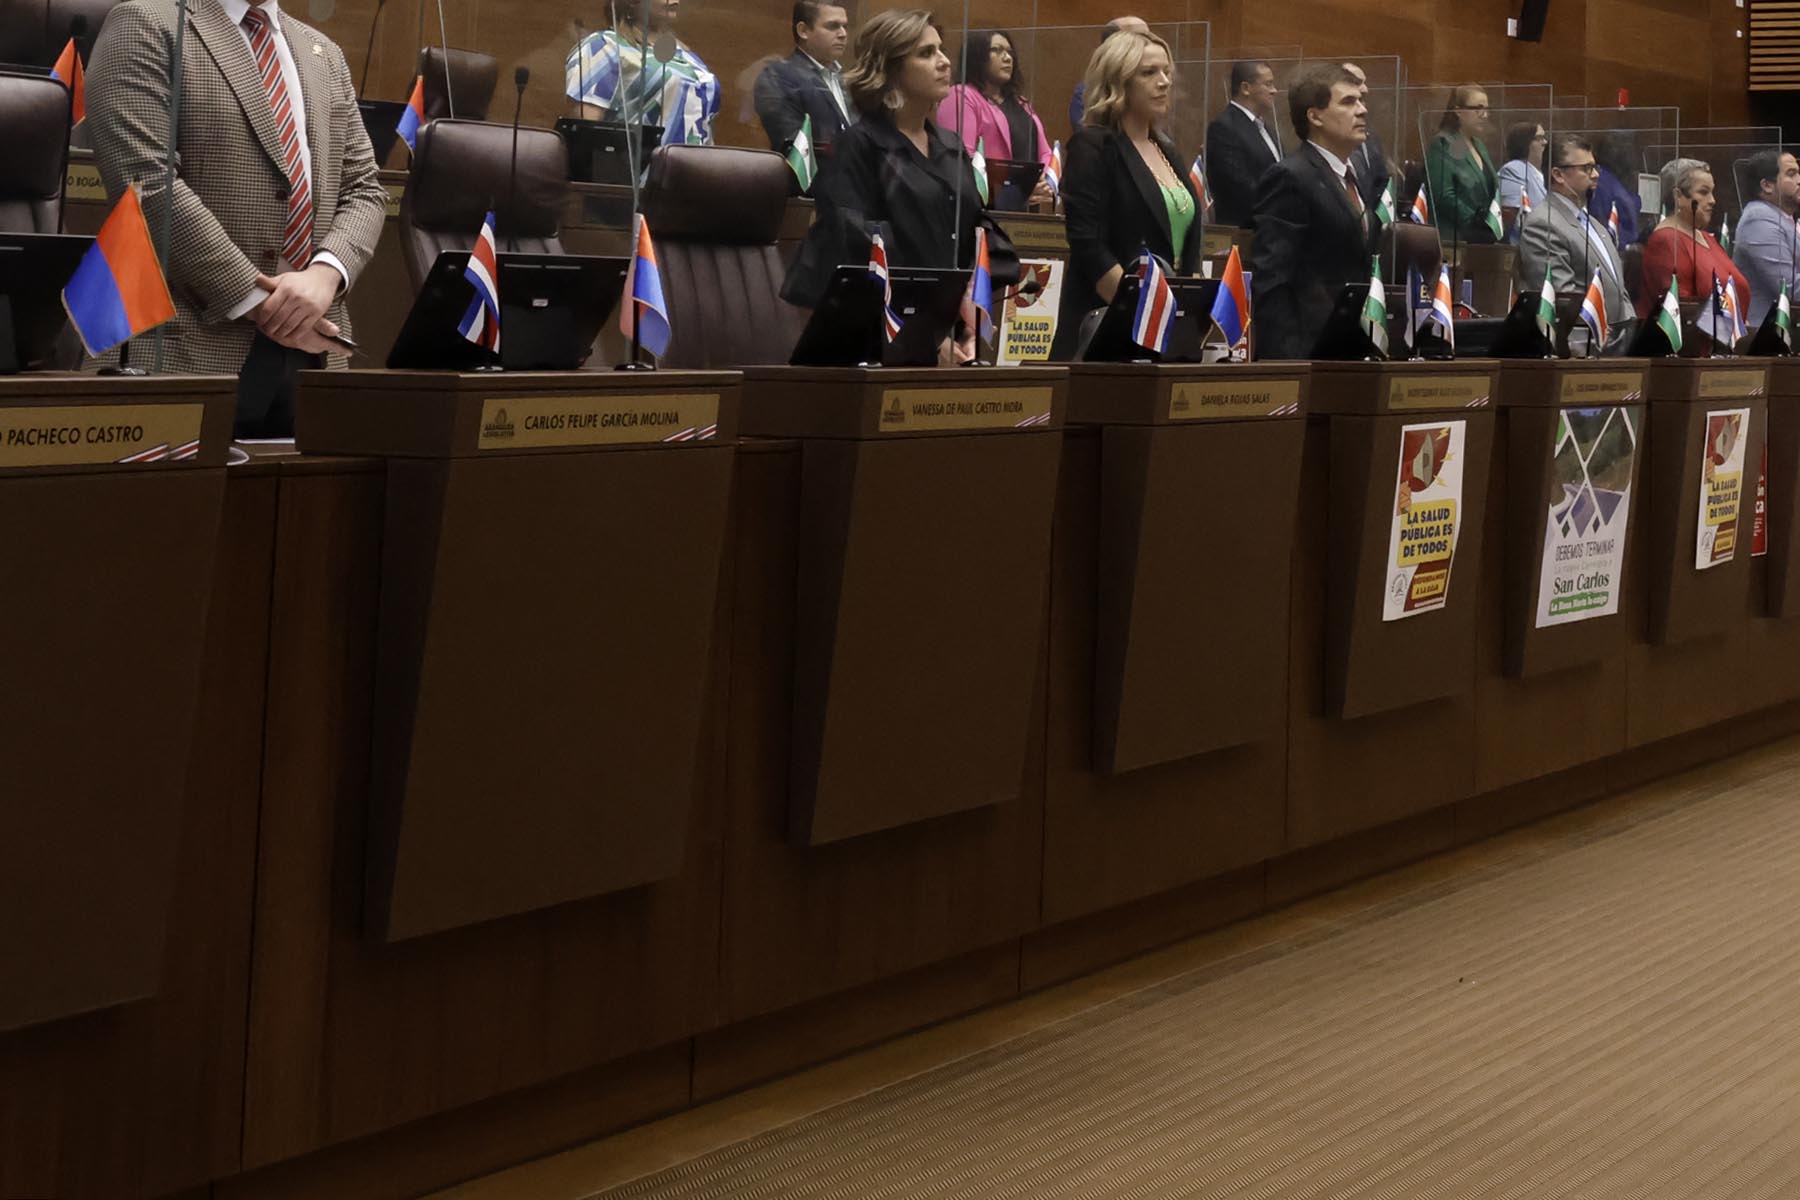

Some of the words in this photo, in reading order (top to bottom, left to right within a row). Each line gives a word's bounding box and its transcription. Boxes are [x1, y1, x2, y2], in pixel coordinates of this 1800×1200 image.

[1013, 322, 1022, 331] LA
[1024, 322, 1049, 331] SALUD
[1042, 333, 1051, 343] ES
[1009, 345, 1018, 354] DE
[1020, 345, 1047, 354] TODOS
[912, 403, 945, 416] VANESSA
[525, 415, 565, 431] CARLOS
[568, 413, 598, 428] FELIPE
[601, 411, 638, 427] GARCÍA
[640, 411, 679, 425] MOLINA
[8, 427, 81, 446] PACHECO
[86, 425, 144, 443] CASTRO
[1407, 512, 1418, 524] LA
[1420, 508, 1450, 523] SALUD
[1401, 525, 1441, 541] PÚBLICA
[1443, 524, 1453, 536] ES
[1403, 545, 1415, 557] DE
[1417, 541, 1448, 555] TODOS
[1553, 577, 1574, 595] San
[1577, 571, 1610, 591] Carlos
